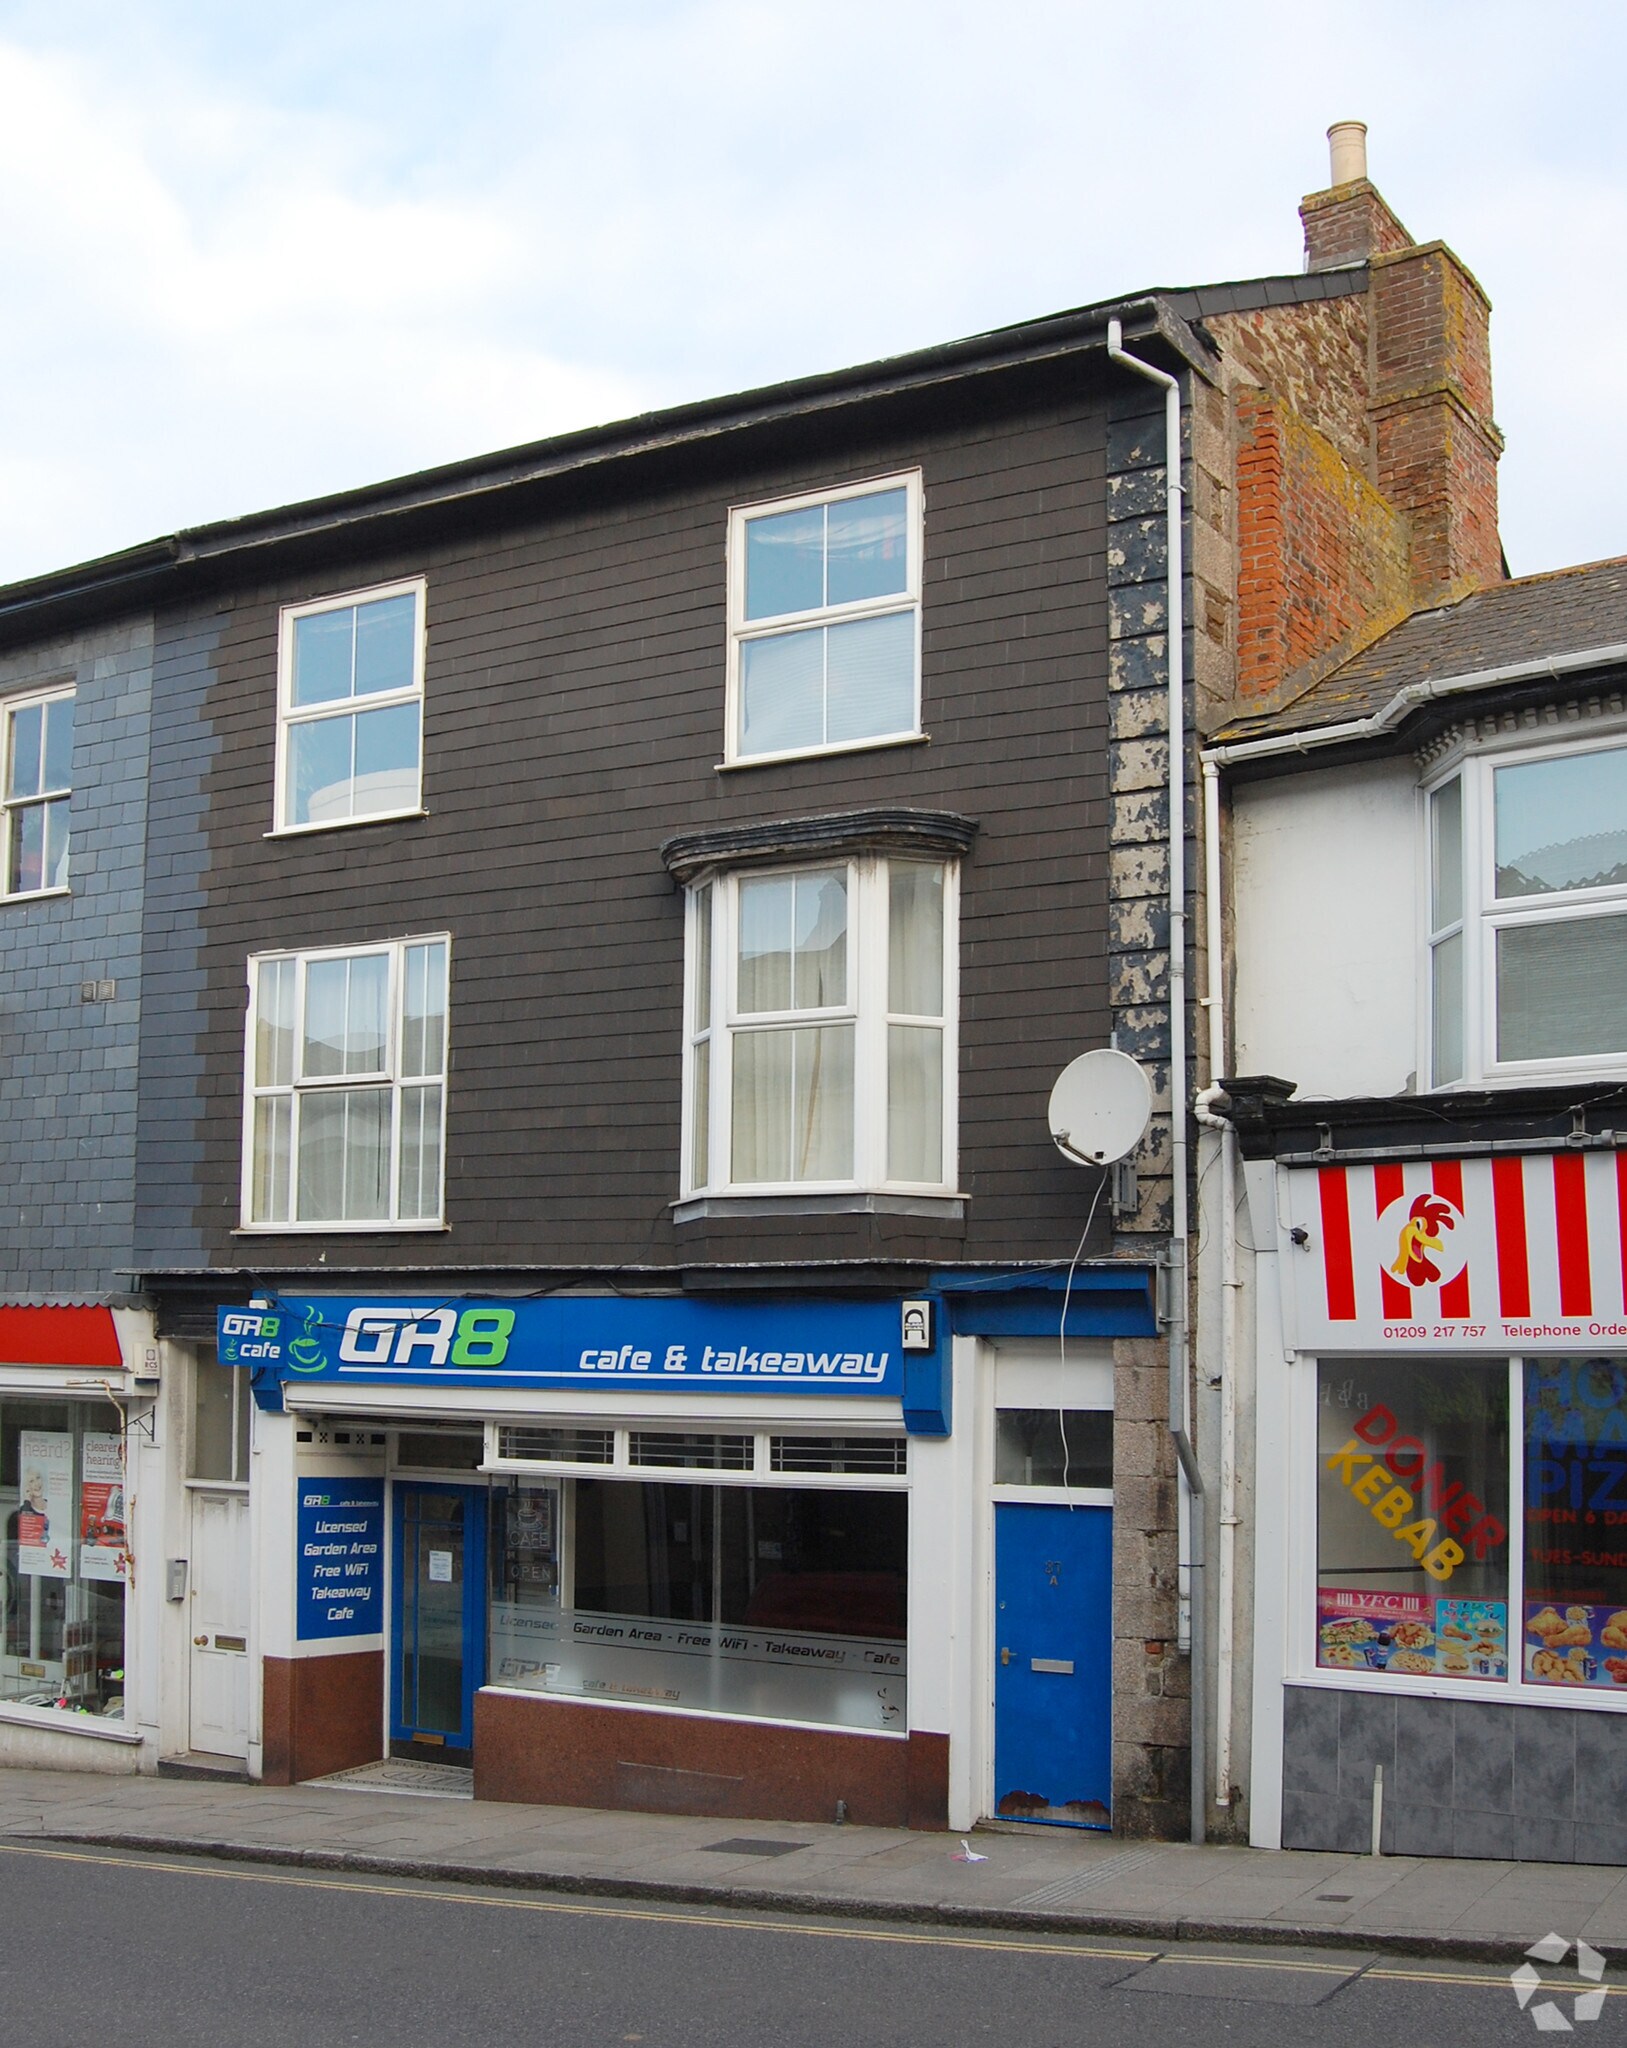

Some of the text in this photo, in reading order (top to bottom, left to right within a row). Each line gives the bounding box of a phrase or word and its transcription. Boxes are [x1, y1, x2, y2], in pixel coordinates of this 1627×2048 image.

[222, 1314, 280, 1337] GR8
[1383, 1326, 1427, 1338] 01209
[1433, 1326, 1455, 1338] 217
[1461, 1325, 1487, 1338] 757
[1502, 1324, 1581, 1338] Telephone
[240, 1342, 281, 1359] cafe
[338, 1307, 888, 1382] GR8 cafe & takeaway
[85, 1440, 118, 1453] clearer
[85, 1453, 121, 1468] hearing
[1353, 1403, 1506, 1560] DONER
[303, 1495, 331, 1506] GR8
[1327, 1439, 1465, 1581] KEBAB
[315, 1521, 367, 1534] Licensed
[304, 1542, 377, 1556] Garden Area
[313, 1563, 369, 1577] Free WiFi
[511, 1564, 550, 1579] OPEN
[311, 1587, 372, 1601] Takeaway
[1356, 1594, 1400, 1608] YFC
[327, 1607, 354, 1620] Cafe
[573, 1622, 624, 1638] Garden
[628, 1628, 662, 1642] Area
[677, 1633, 711, 1647] Free
[719, 1636, 748, 1650] WiFi
[765, 1641, 846, 1664] Takeaway
[864, 1651, 900, 1665] Cafe
